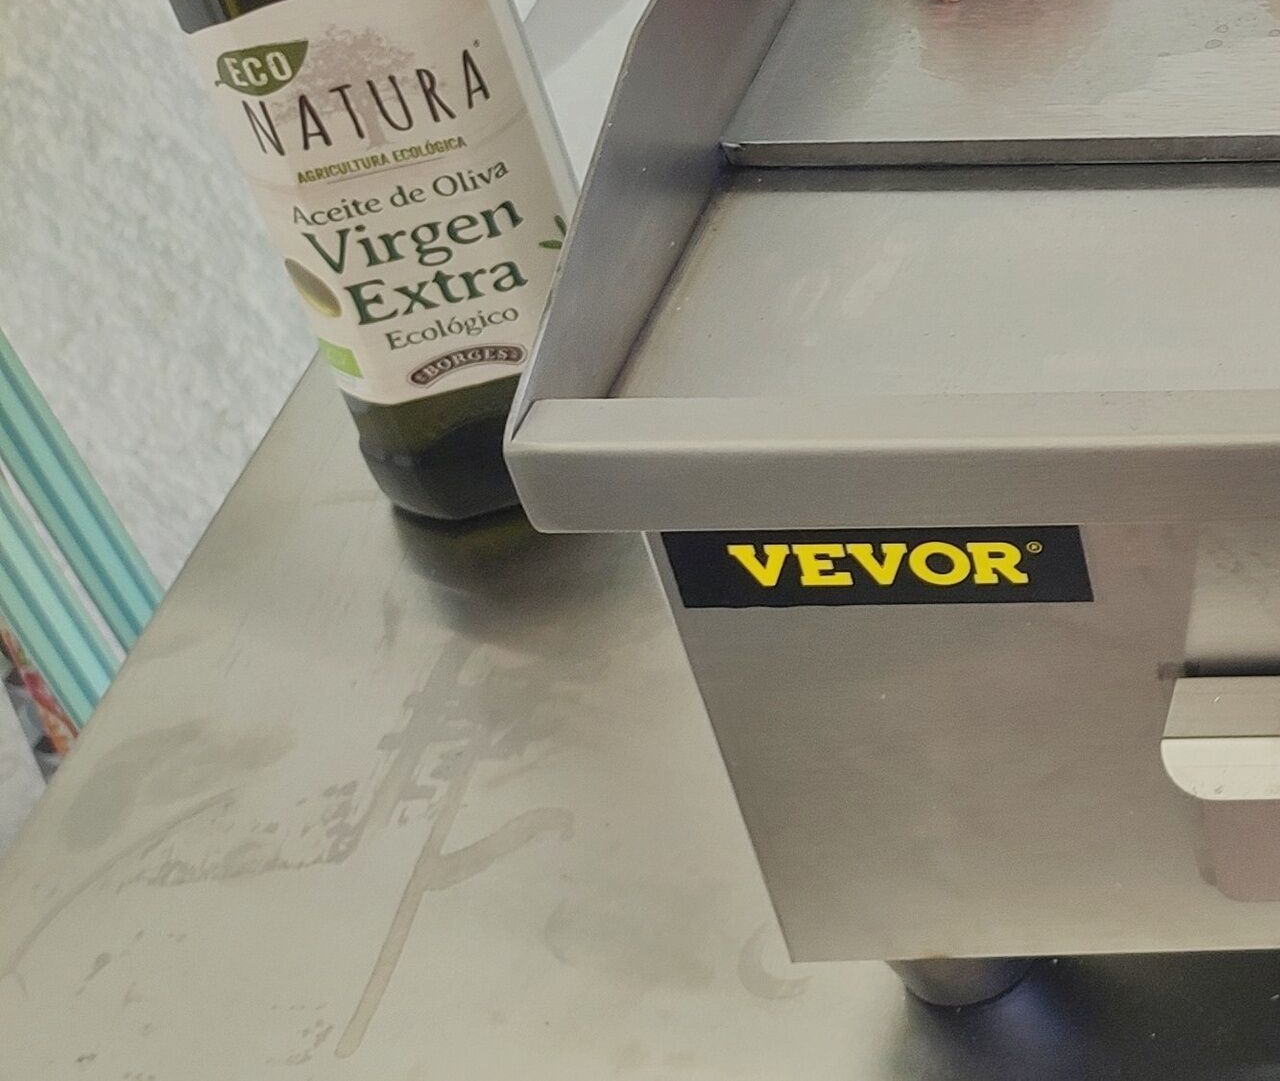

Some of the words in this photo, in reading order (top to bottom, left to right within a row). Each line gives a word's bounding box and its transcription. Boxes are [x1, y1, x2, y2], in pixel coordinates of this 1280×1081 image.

[223, 51, 294, 88] ECO
[241, 49, 490, 157] NATURA
[297, 153, 391, 185] AGRICULTURA
[393, 136, 468, 162] ECOLÓGICA
[292, 197, 384, 227] Aceite
[389, 185, 427, 208] de
[432, 161, 509, 198] Oliva
[301, 199, 524, 275] Virgen
[344, 259, 529, 326] Extra
[385, 307, 519, 351] Ecológico
[424, 347, 511, 378] BORGES
